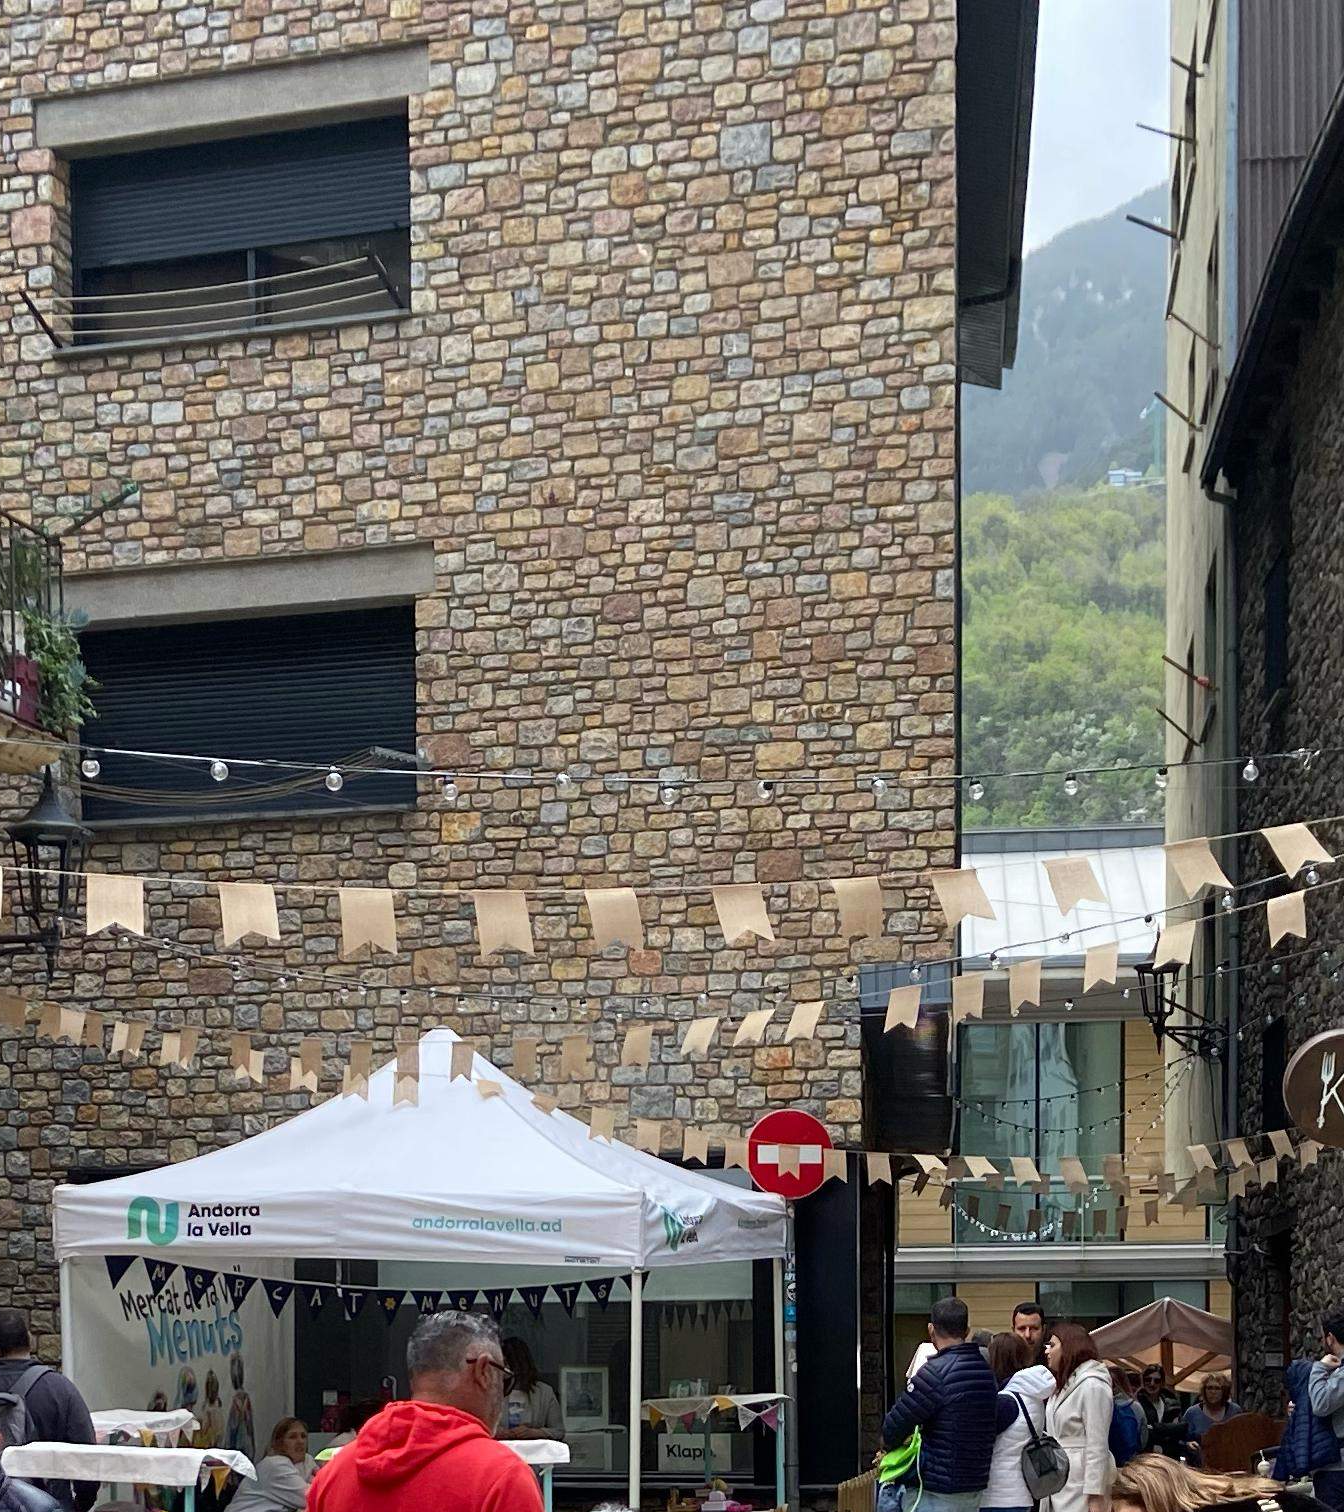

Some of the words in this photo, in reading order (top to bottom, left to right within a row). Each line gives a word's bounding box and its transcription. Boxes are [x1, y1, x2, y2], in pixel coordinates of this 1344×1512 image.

[188, 1203, 260, 1218] Andorra
[187, 1223, 203, 1237] la
[208, 1222, 252, 1237] Vella
[412, 1216, 562, 1233] andorralavella.ad
[119, 1282, 181, 1322] Mercat
[145, 1300, 243, 1367] Menuts
